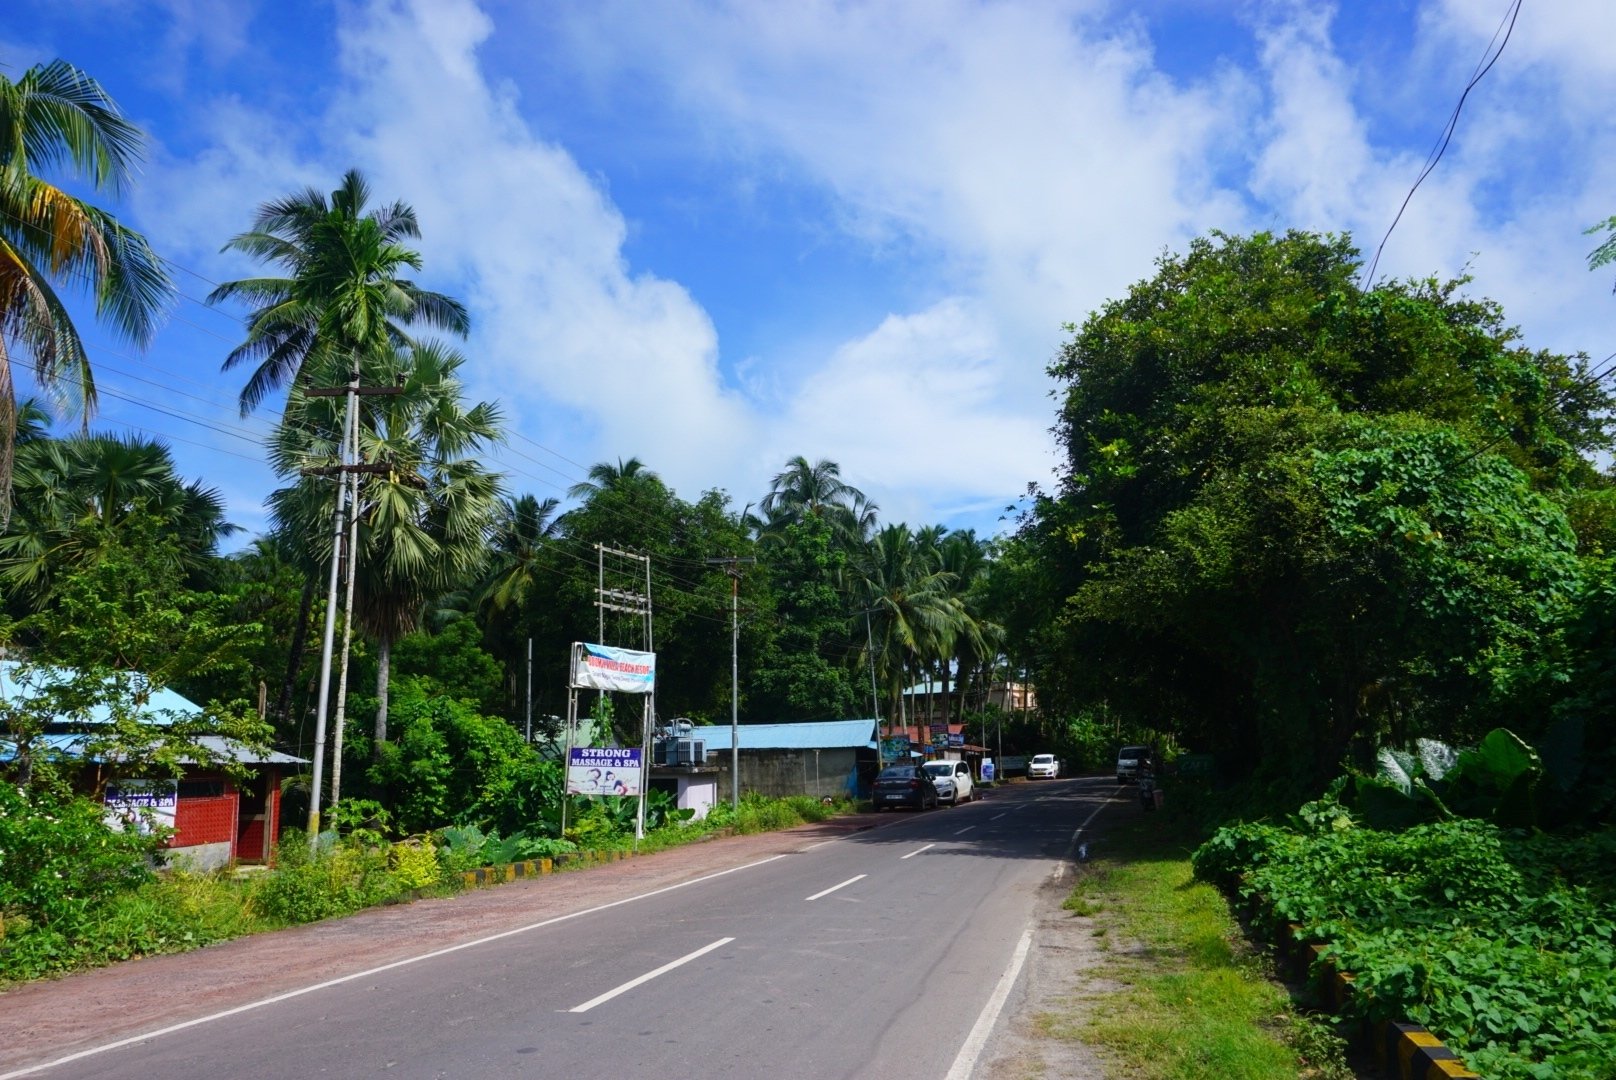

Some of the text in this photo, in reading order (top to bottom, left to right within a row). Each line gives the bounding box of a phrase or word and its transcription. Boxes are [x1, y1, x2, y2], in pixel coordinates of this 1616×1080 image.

[581, 748, 631, 757] STRONG
[571, 758, 612, 767] MASSAGE
[623, 759, 639, 767] SPA
[158, 797, 174, 807] SPA
